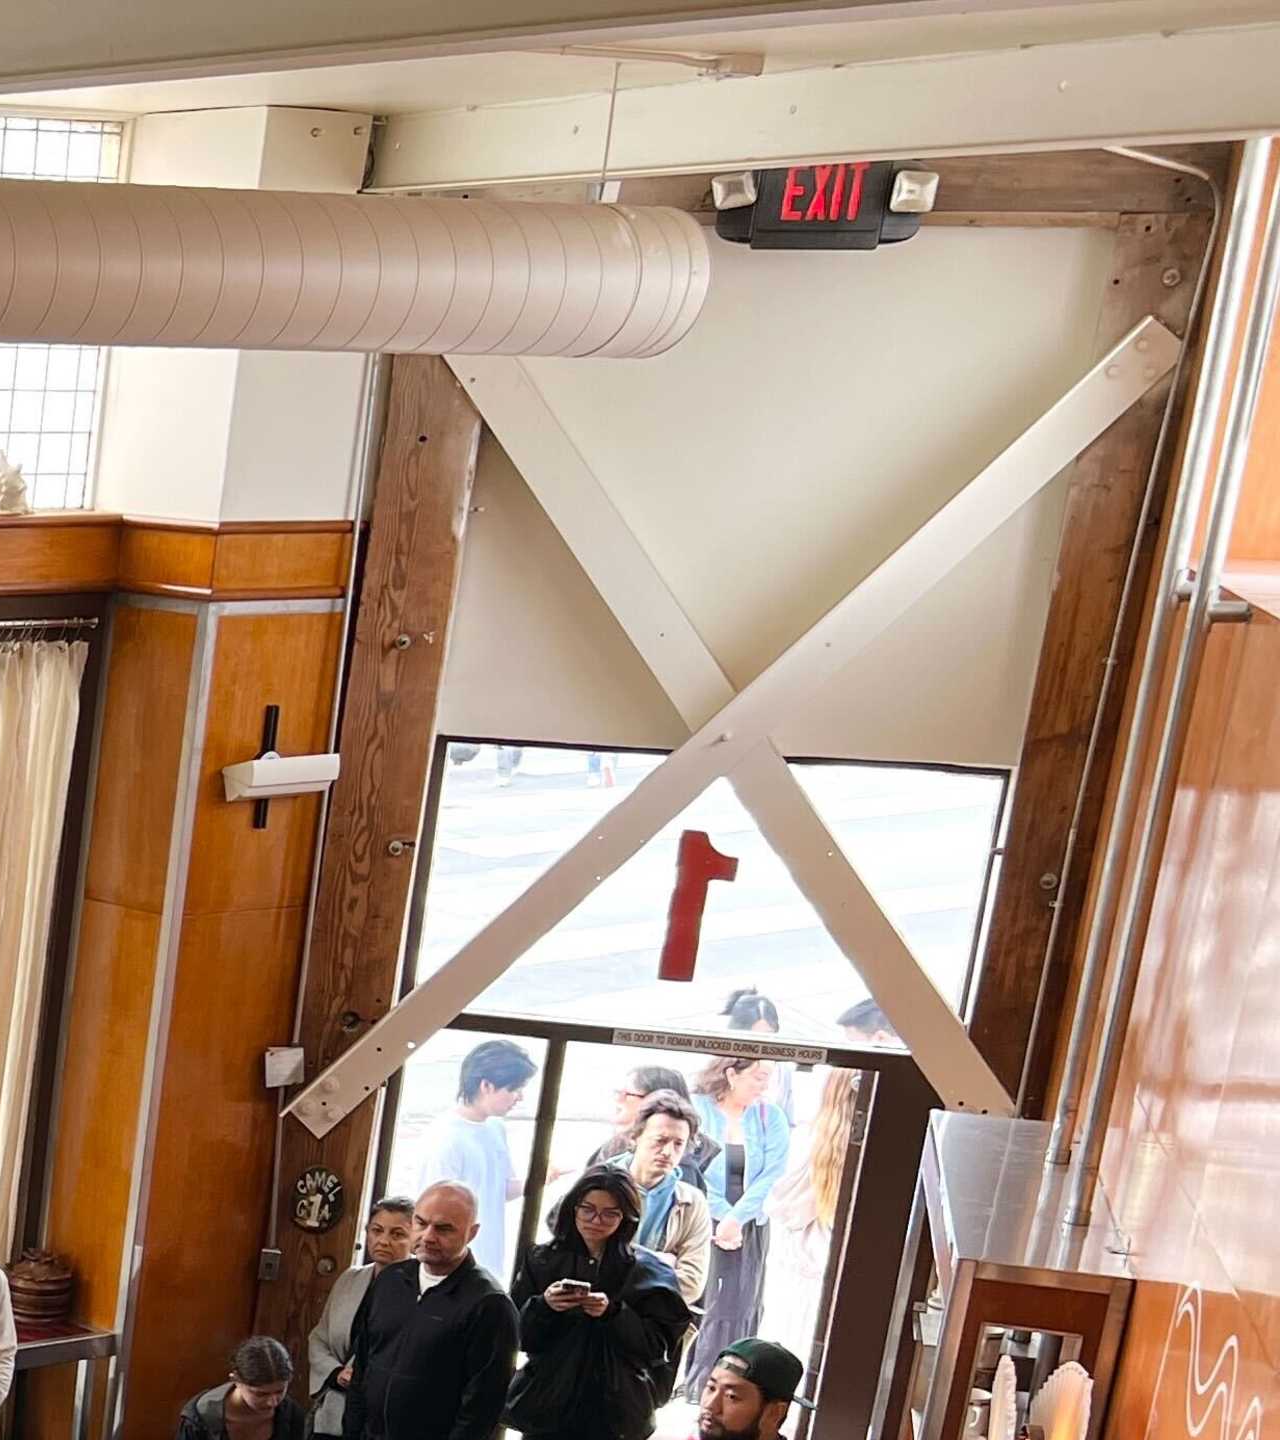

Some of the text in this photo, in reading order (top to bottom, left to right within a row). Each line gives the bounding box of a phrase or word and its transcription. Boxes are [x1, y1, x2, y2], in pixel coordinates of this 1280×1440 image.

[780, 161, 871, 221] EXIT
[633, 1033, 655, 1044] DOOR
[656, 1035, 666, 1046] TO
[666, 1036, 692, 1048] REMAIN
[693, 1038, 731, 1051] UNLOCKED
[732, 1042, 760, 1054] DURING
[761, 1044, 796, 1057] BUSINESS
[797, 1048, 824, 1060] HOURS
